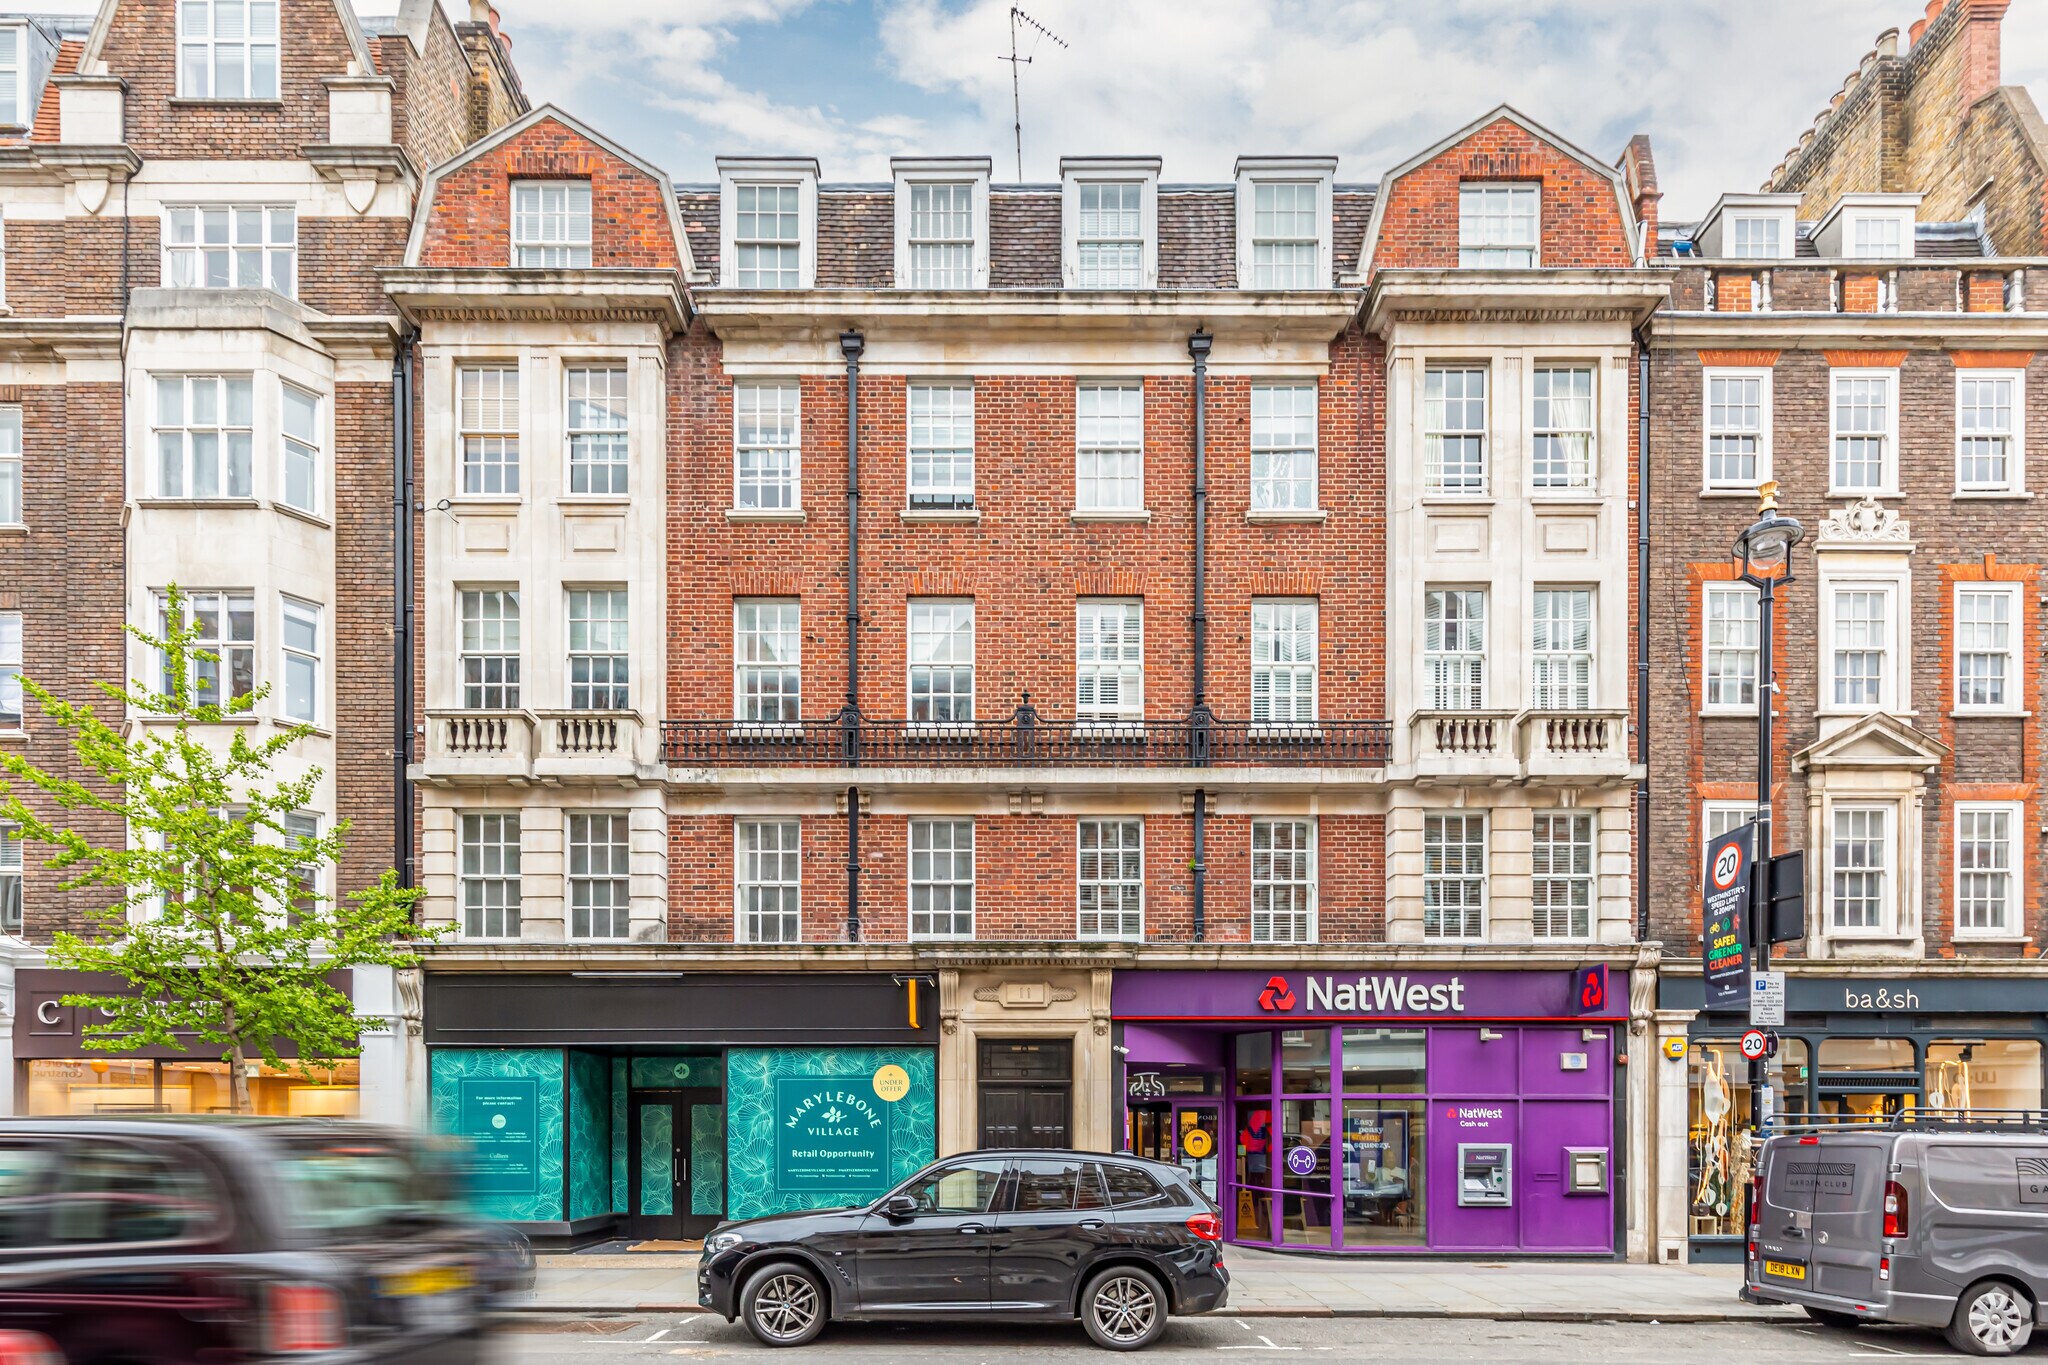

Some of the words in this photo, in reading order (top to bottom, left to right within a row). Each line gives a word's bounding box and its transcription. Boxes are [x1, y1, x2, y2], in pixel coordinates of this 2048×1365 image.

[1717, 853, 1736, 878] 20
[1707, 886, 1746, 904] WESTMINSTER'S
[1711, 900, 1726, 910] SPEED
[1726, 894, 1740, 905] LIMIT
[1714, 934, 1736, 949] SAFER
[1708, 944, 1742, 960] GREENER
[1709, 954, 1742, 970] CLEANER
[1758, 981, 1765, 990] P
[1306, 976, 1465, 1011] NatWest
[1846, 988, 1919, 1009] ba&sh
[37, 1000, 61, 1024] C
[1745, 1038, 1762, 1050] 20
[785, 1092, 882, 1128] MARYLEBONE
[1459, 1108, 1503, 1119] NatWest
[1354, 1118, 1374, 1126] Easy
[808, 1128, 859, 1136] VILLAGE
[1358, 1126, 1384, 1134] peasy
[792, 1150, 818, 1158] Retail
[820, 1150, 875, 1159] Opportunity
[1770, 1262, 1785, 1273] DE18
[1786, 1264, 1800, 1276] LXN
